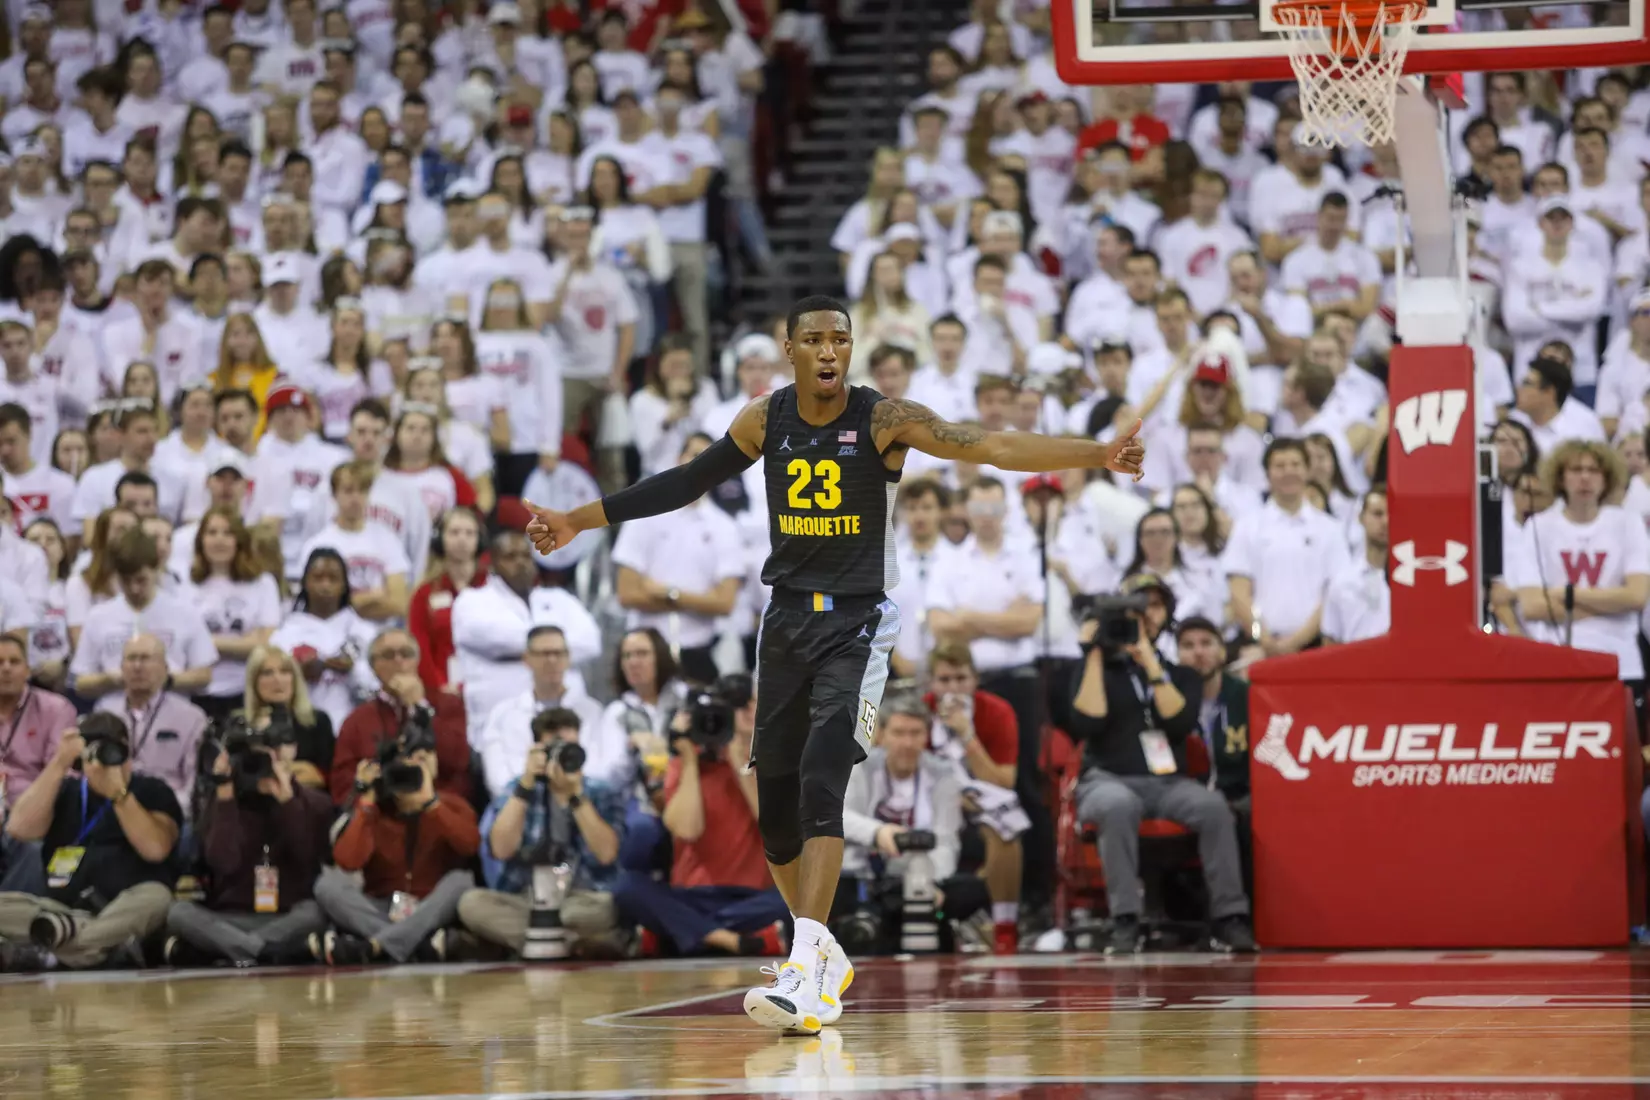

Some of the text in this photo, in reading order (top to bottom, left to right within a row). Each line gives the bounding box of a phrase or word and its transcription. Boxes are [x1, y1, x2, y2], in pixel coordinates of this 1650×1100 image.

[1393, 388, 1468, 455] W
[787, 458, 842, 510] 23
[778, 514, 861, 537] MARQUETTE
[1559, 551, 1608, 589] W
[1224, 724, 1249, 755] M
[1298, 721, 1613, 763] MUELLER
[1352, 762, 1557, 788] SPORTS MEDICINE
